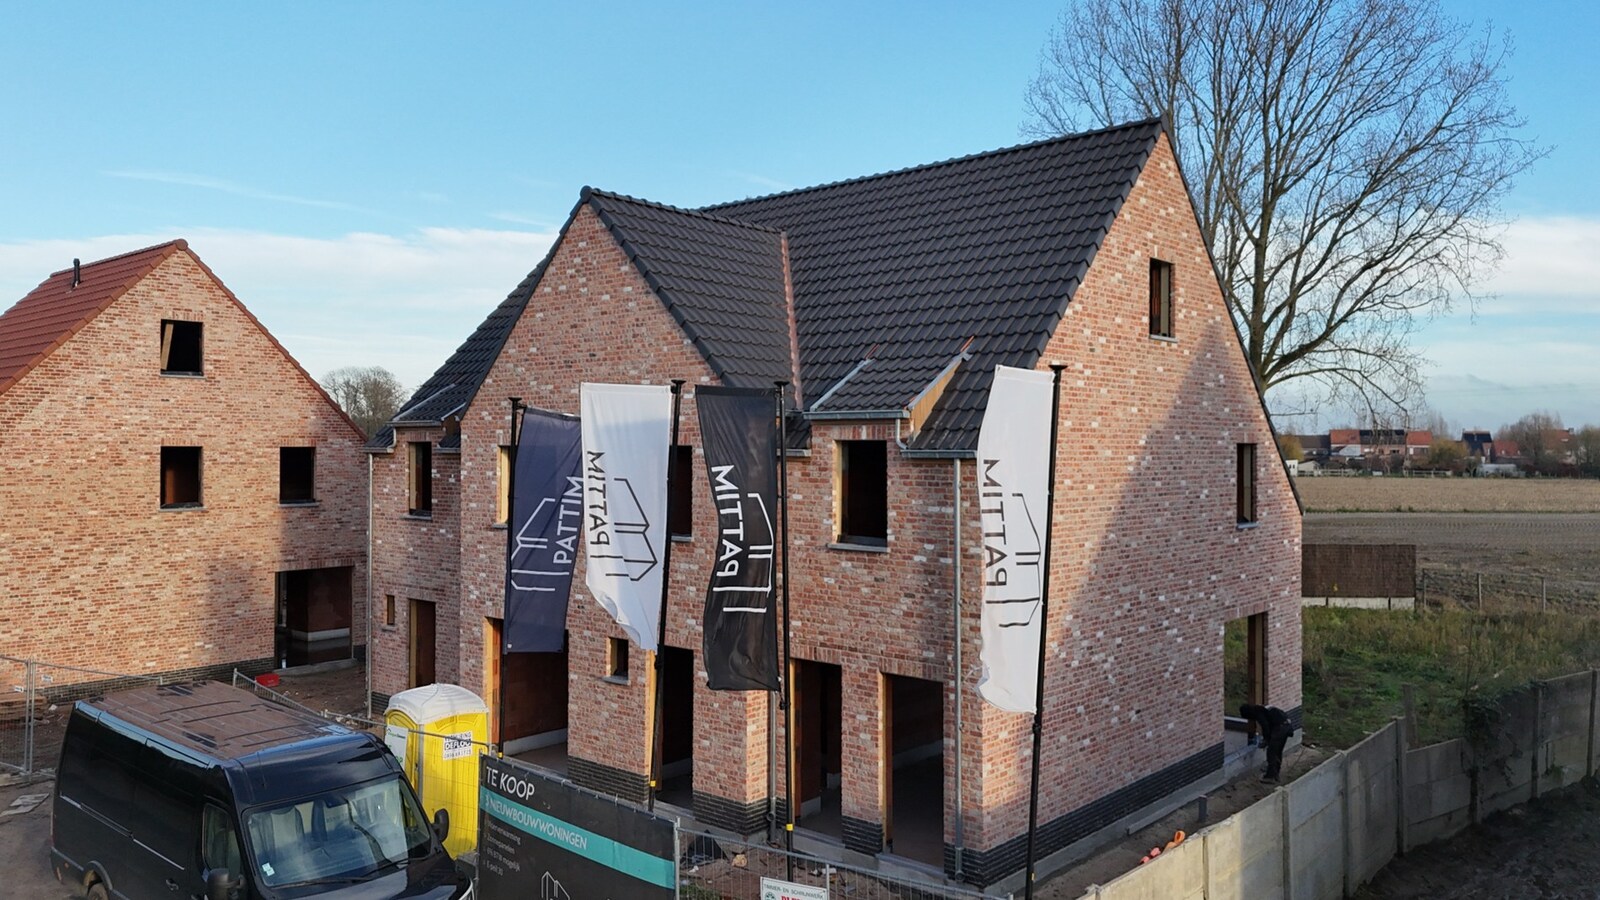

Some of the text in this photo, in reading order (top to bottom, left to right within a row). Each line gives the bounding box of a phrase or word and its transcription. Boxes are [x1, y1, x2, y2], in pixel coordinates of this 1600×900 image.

[553, 476, 584, 564] PATTIM
[486, 766, 535, 800] TE KOOP
[490, 797, 588, 850] NIEUWBOUWWONINGEN
